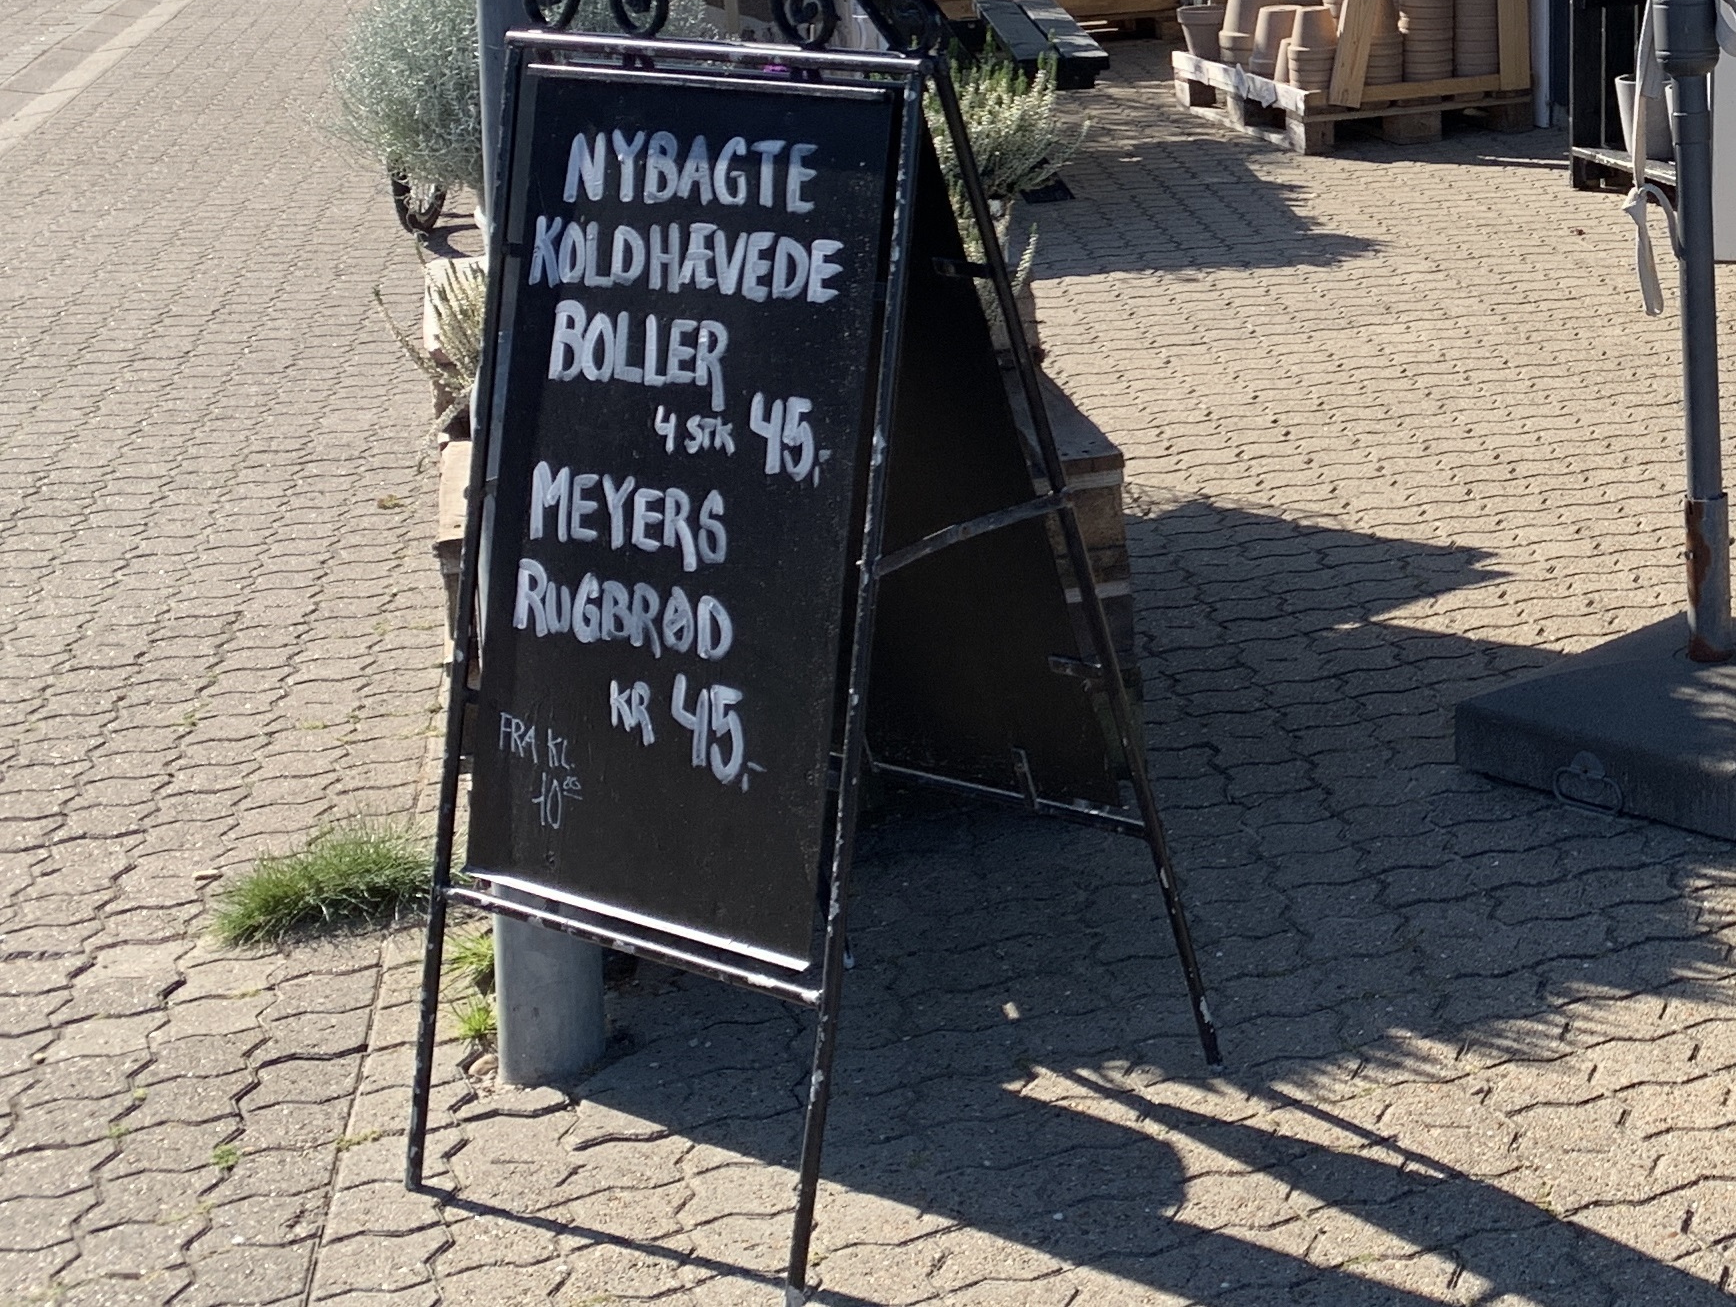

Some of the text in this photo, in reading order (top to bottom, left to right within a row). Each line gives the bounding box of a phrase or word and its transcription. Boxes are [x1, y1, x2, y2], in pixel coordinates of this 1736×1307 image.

[563, 130, 819, 214] NYBAGTE
[529, 215, 845, 304] KOLDHÆVEDE
[548, 299, 728, 412] BOLLER
[653, 404, 677, 456] 4
[529, 460, 728, 571] MEYERS
[512, 557, 734, 662] RUGBRØD
[498, 711, 539, 765] FRA
[609, 679, 656, 748] KR
